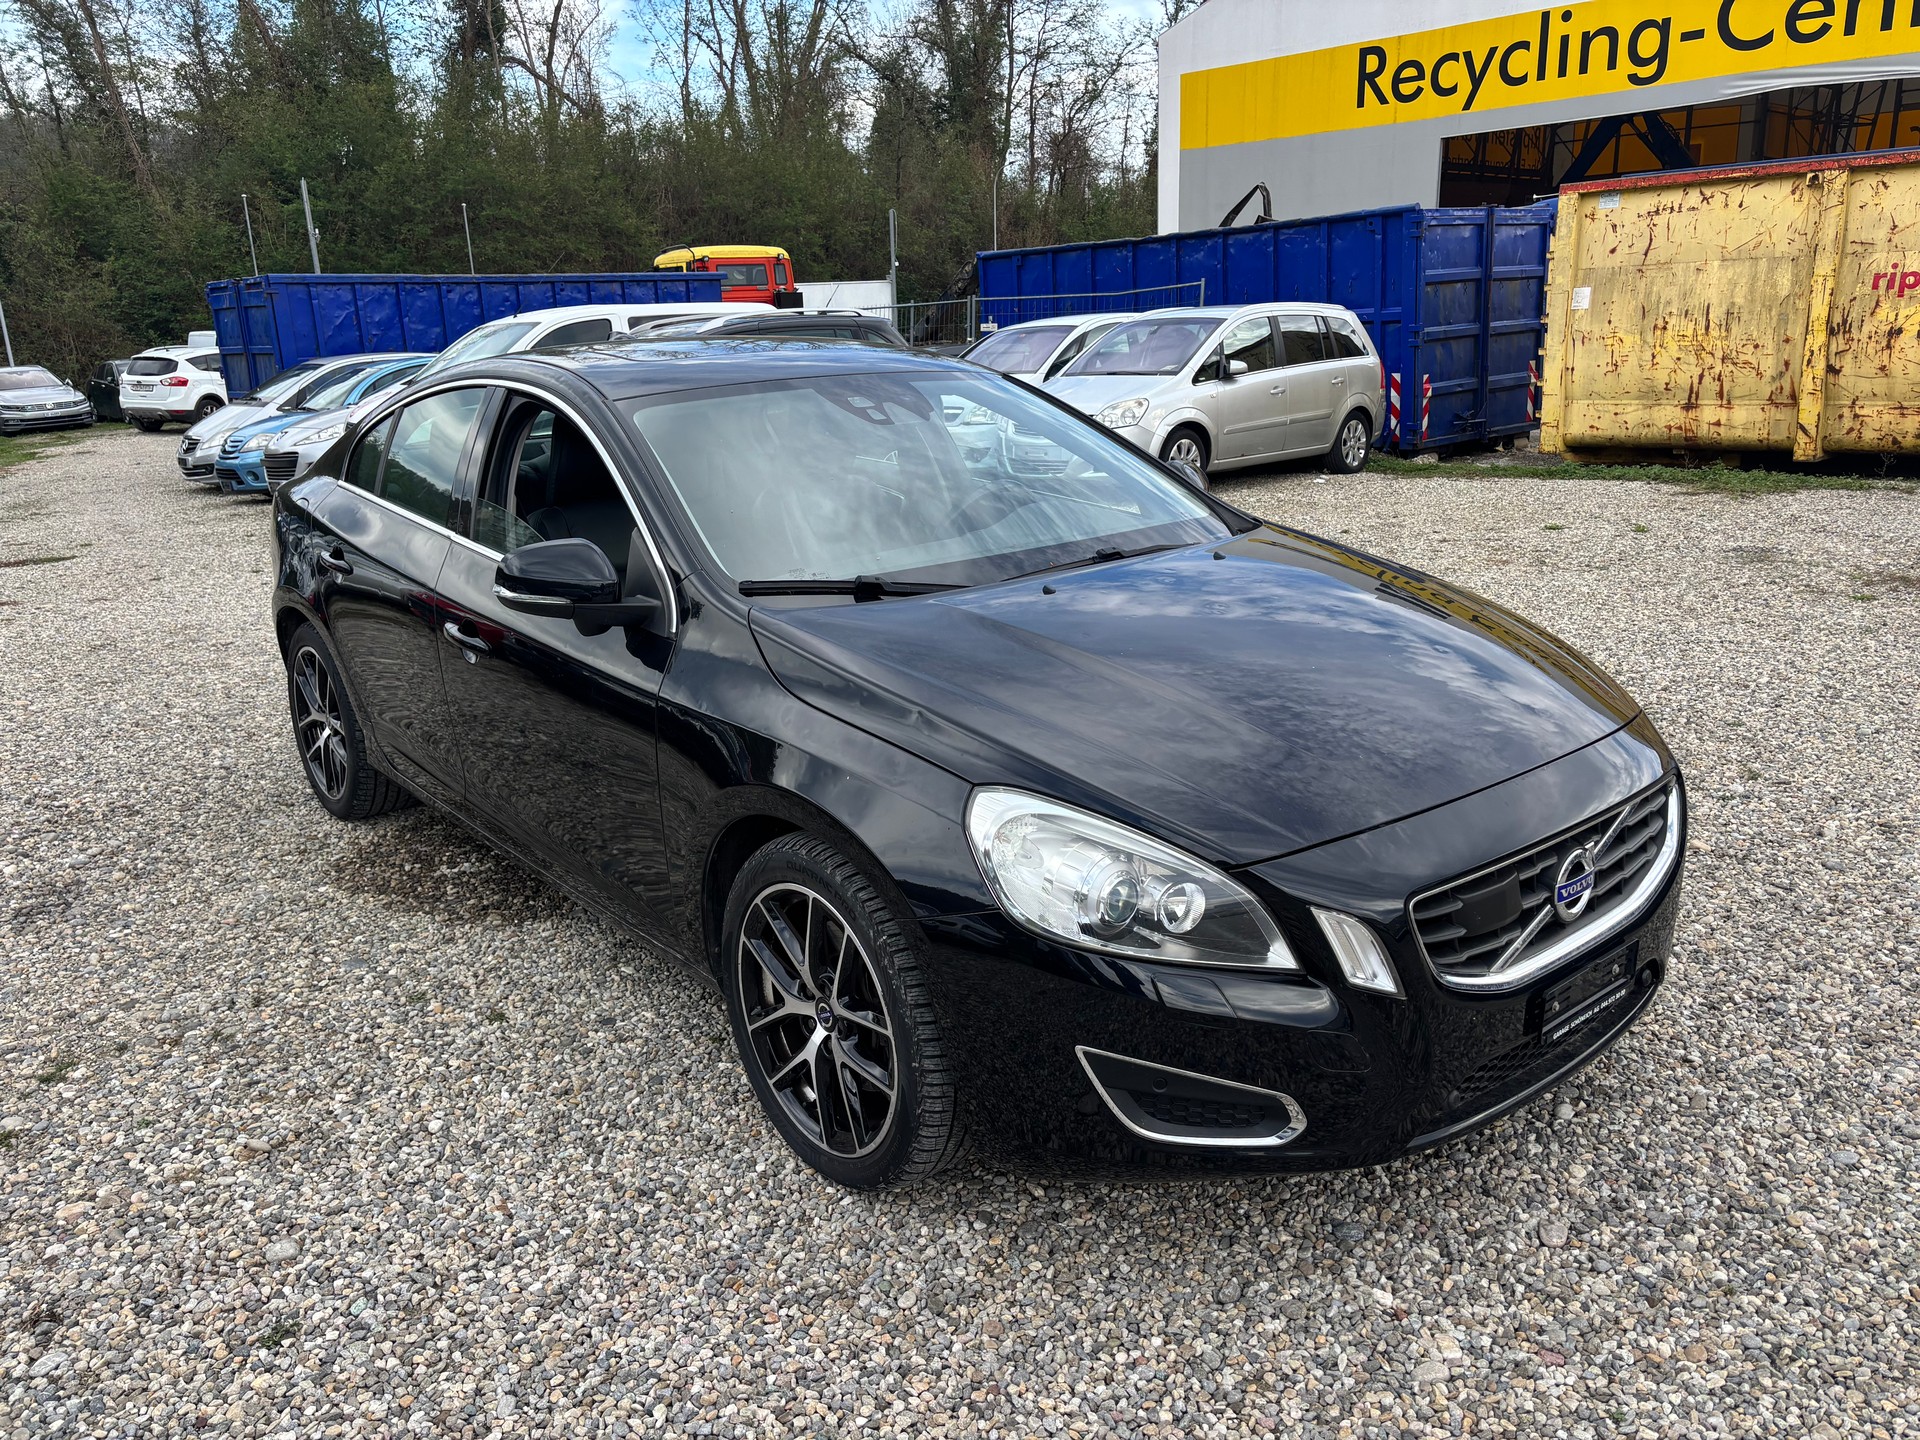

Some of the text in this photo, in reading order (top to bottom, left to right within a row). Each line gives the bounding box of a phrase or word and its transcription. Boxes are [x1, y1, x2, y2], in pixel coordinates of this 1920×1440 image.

[1560, 874, 1594, 898] VOLVO
[1552, 1024, 1570, 1040] GARAGE
[1593, 1005, 1600, 1014] AG
